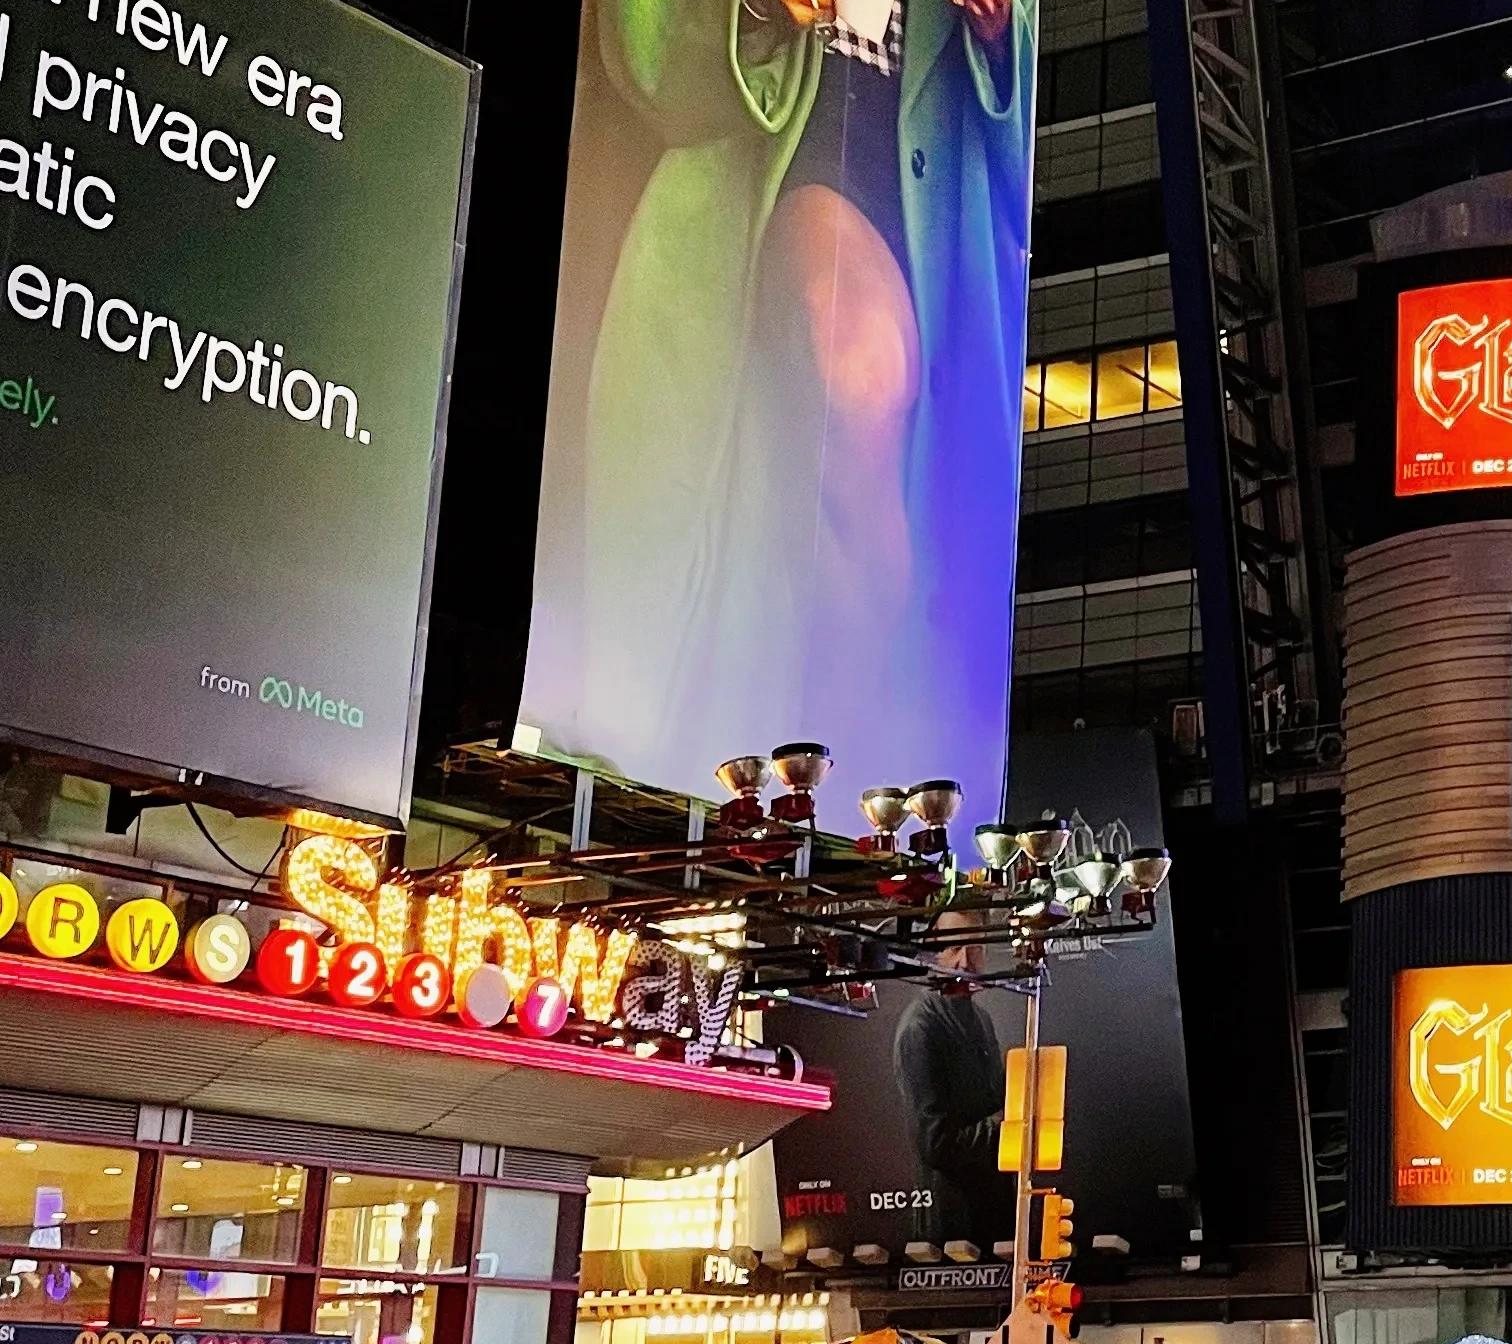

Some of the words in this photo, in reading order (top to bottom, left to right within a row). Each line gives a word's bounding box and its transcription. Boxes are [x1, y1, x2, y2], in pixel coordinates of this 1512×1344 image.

[33, 50, 276, 208] privacy
[248, 55, 344, 140] era
[0, 139, 116, 230] atic
[7, 263, 372, 445] encryption.
[1472, 459, 1504, 474] DEC
[200, 666, 251, 699] from
[297, 686, 365, 729] Meta
[48, 896, 86, 944] R
[128, 914, 171, 966] W
[204, 924, 240, 972] S
[285, 940, 307, 985] 1
[346, 956, 375, 998] 2
[411, 961, 441, 1008] 3
[536, 983, 561, 1028] 7
[870, 1191, 907, 1210] DEC
[911, 1189, 933, 1208] 23
[1398, 1168, 1453, 1187] NETFLIX
[1473, 1168, 1507, 1184] DEC
[904, 1268, 1001, 1287] OUTFRONT
